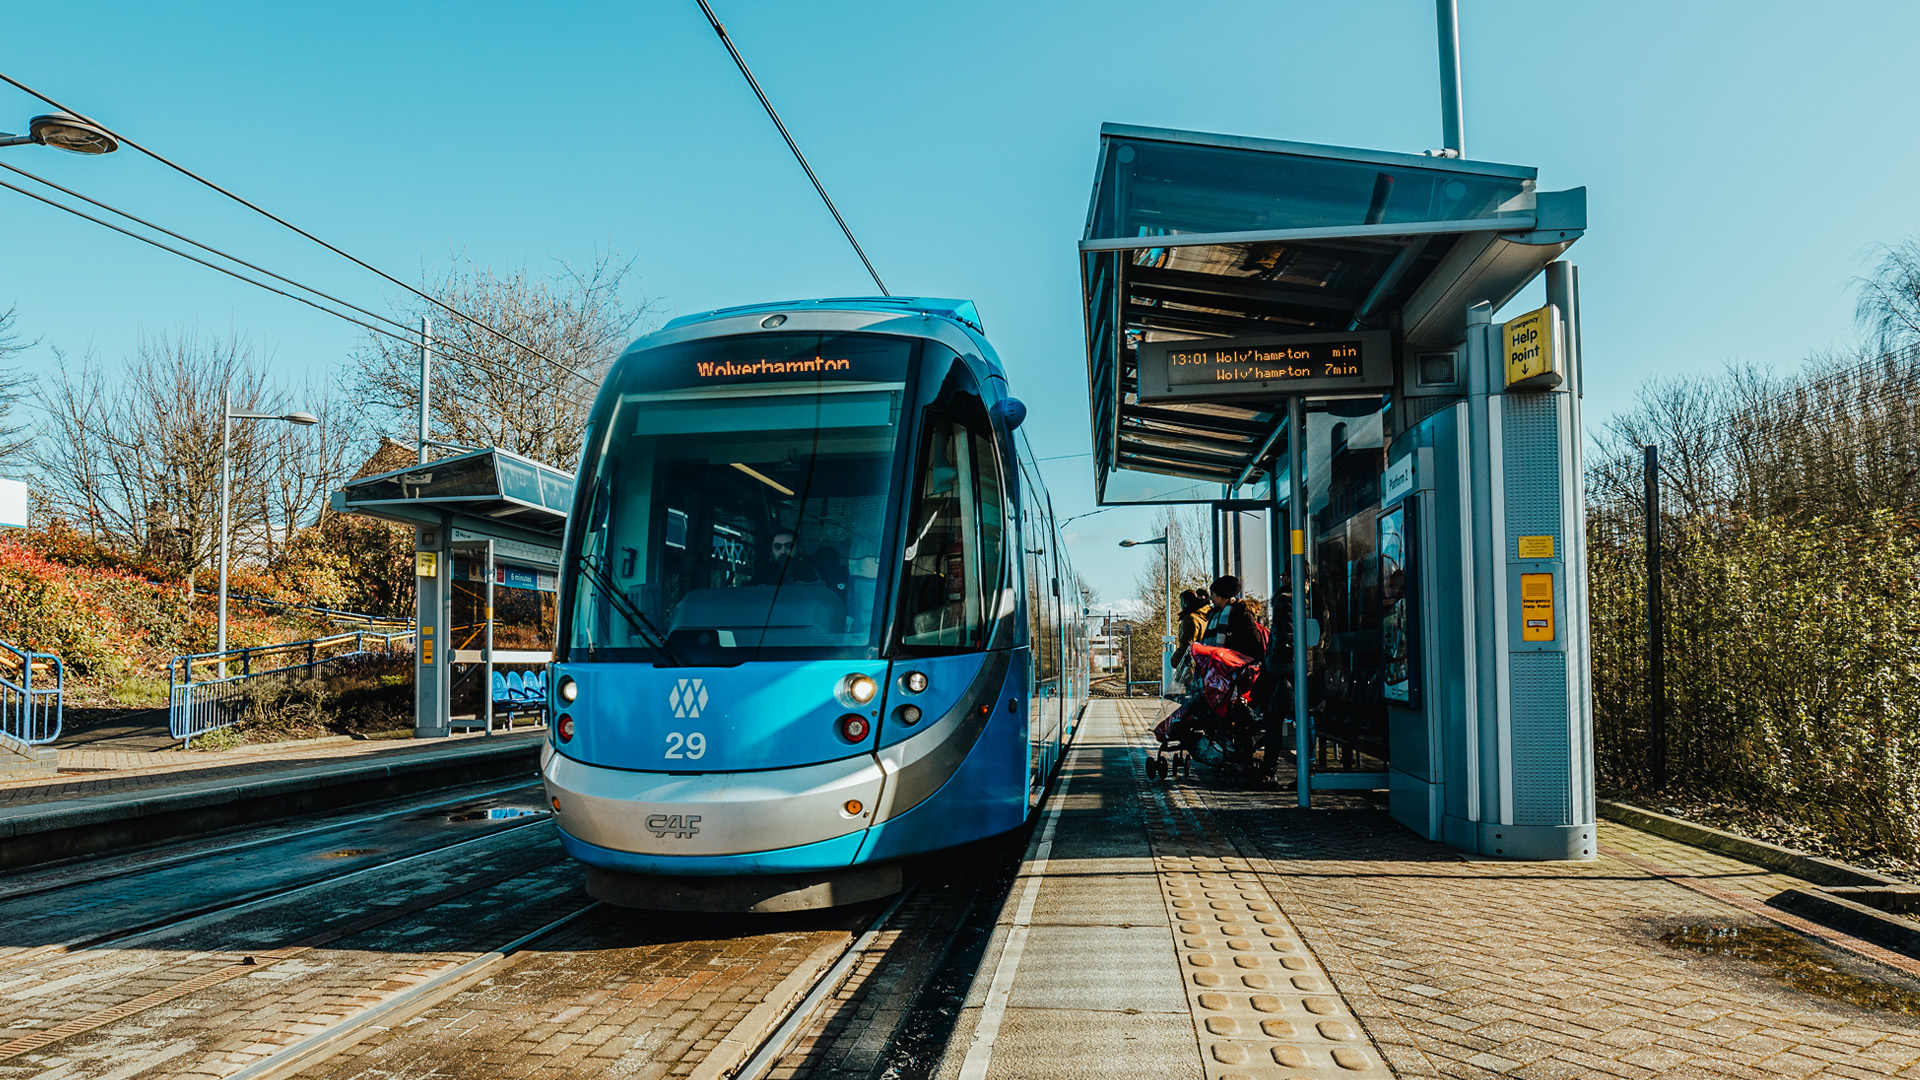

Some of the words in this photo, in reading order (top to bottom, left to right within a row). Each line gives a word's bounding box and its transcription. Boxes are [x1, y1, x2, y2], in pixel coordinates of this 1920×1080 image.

[1511, 316, 1539, 331] Emergency
[1512, 328, 1538, 347] Help
[1171, 352, 1208, 366] 13:01
[1216, 348, 1310, 364] Wolv'hampton
[1332, 345, 1357, 358] min
[1512, 344, 1540, 365] Point
[1216, 365, 1311, 381] Wolv'hampton
[1324, 362, 1358, 376] 7min
[515, 573, 532, 583] minutes
[664, 732, 707, 760] 29
[645, 814, 702, 839] CAF
